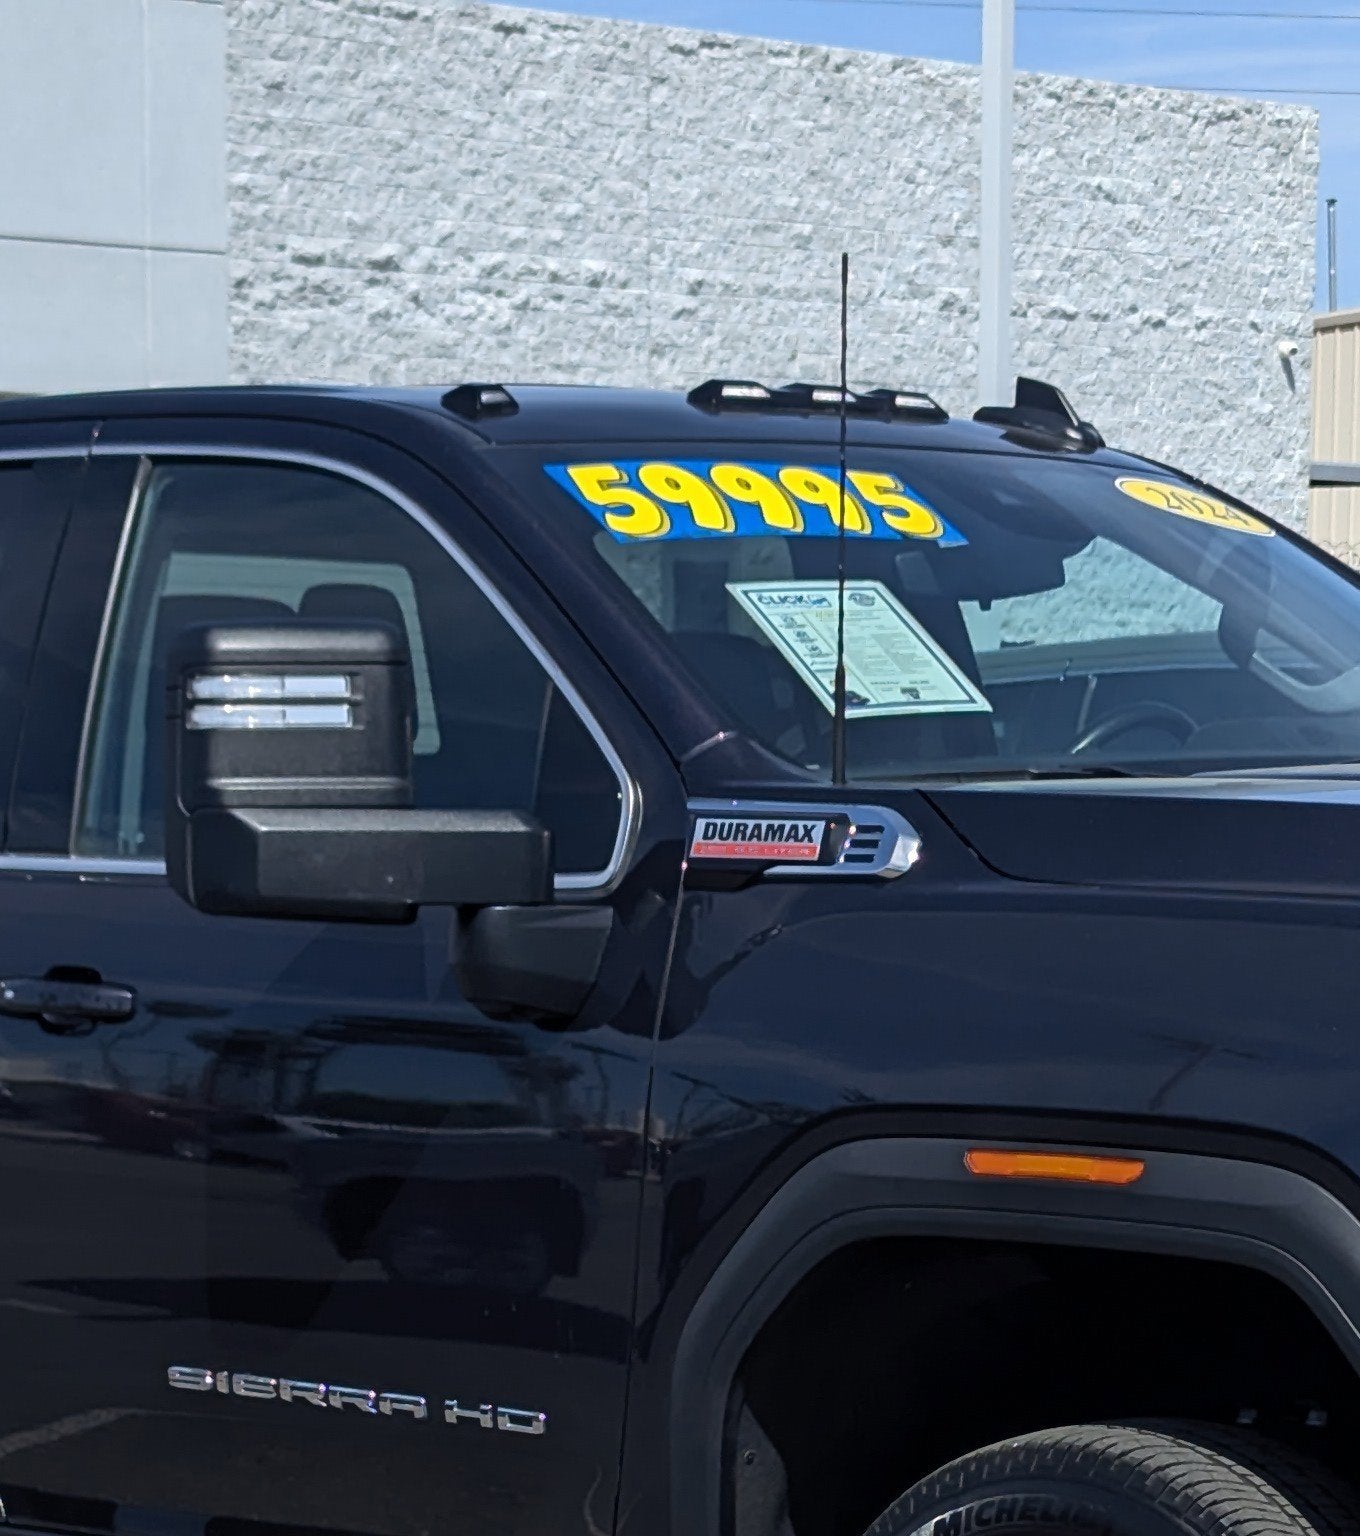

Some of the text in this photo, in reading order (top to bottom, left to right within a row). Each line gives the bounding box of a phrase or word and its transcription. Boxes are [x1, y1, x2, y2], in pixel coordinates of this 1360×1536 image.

[567, 463, 944, 539] 59995
[702, 821, 817, 843] DURAMAX
[167, 1366, 546, 1434] SIERRA HD
